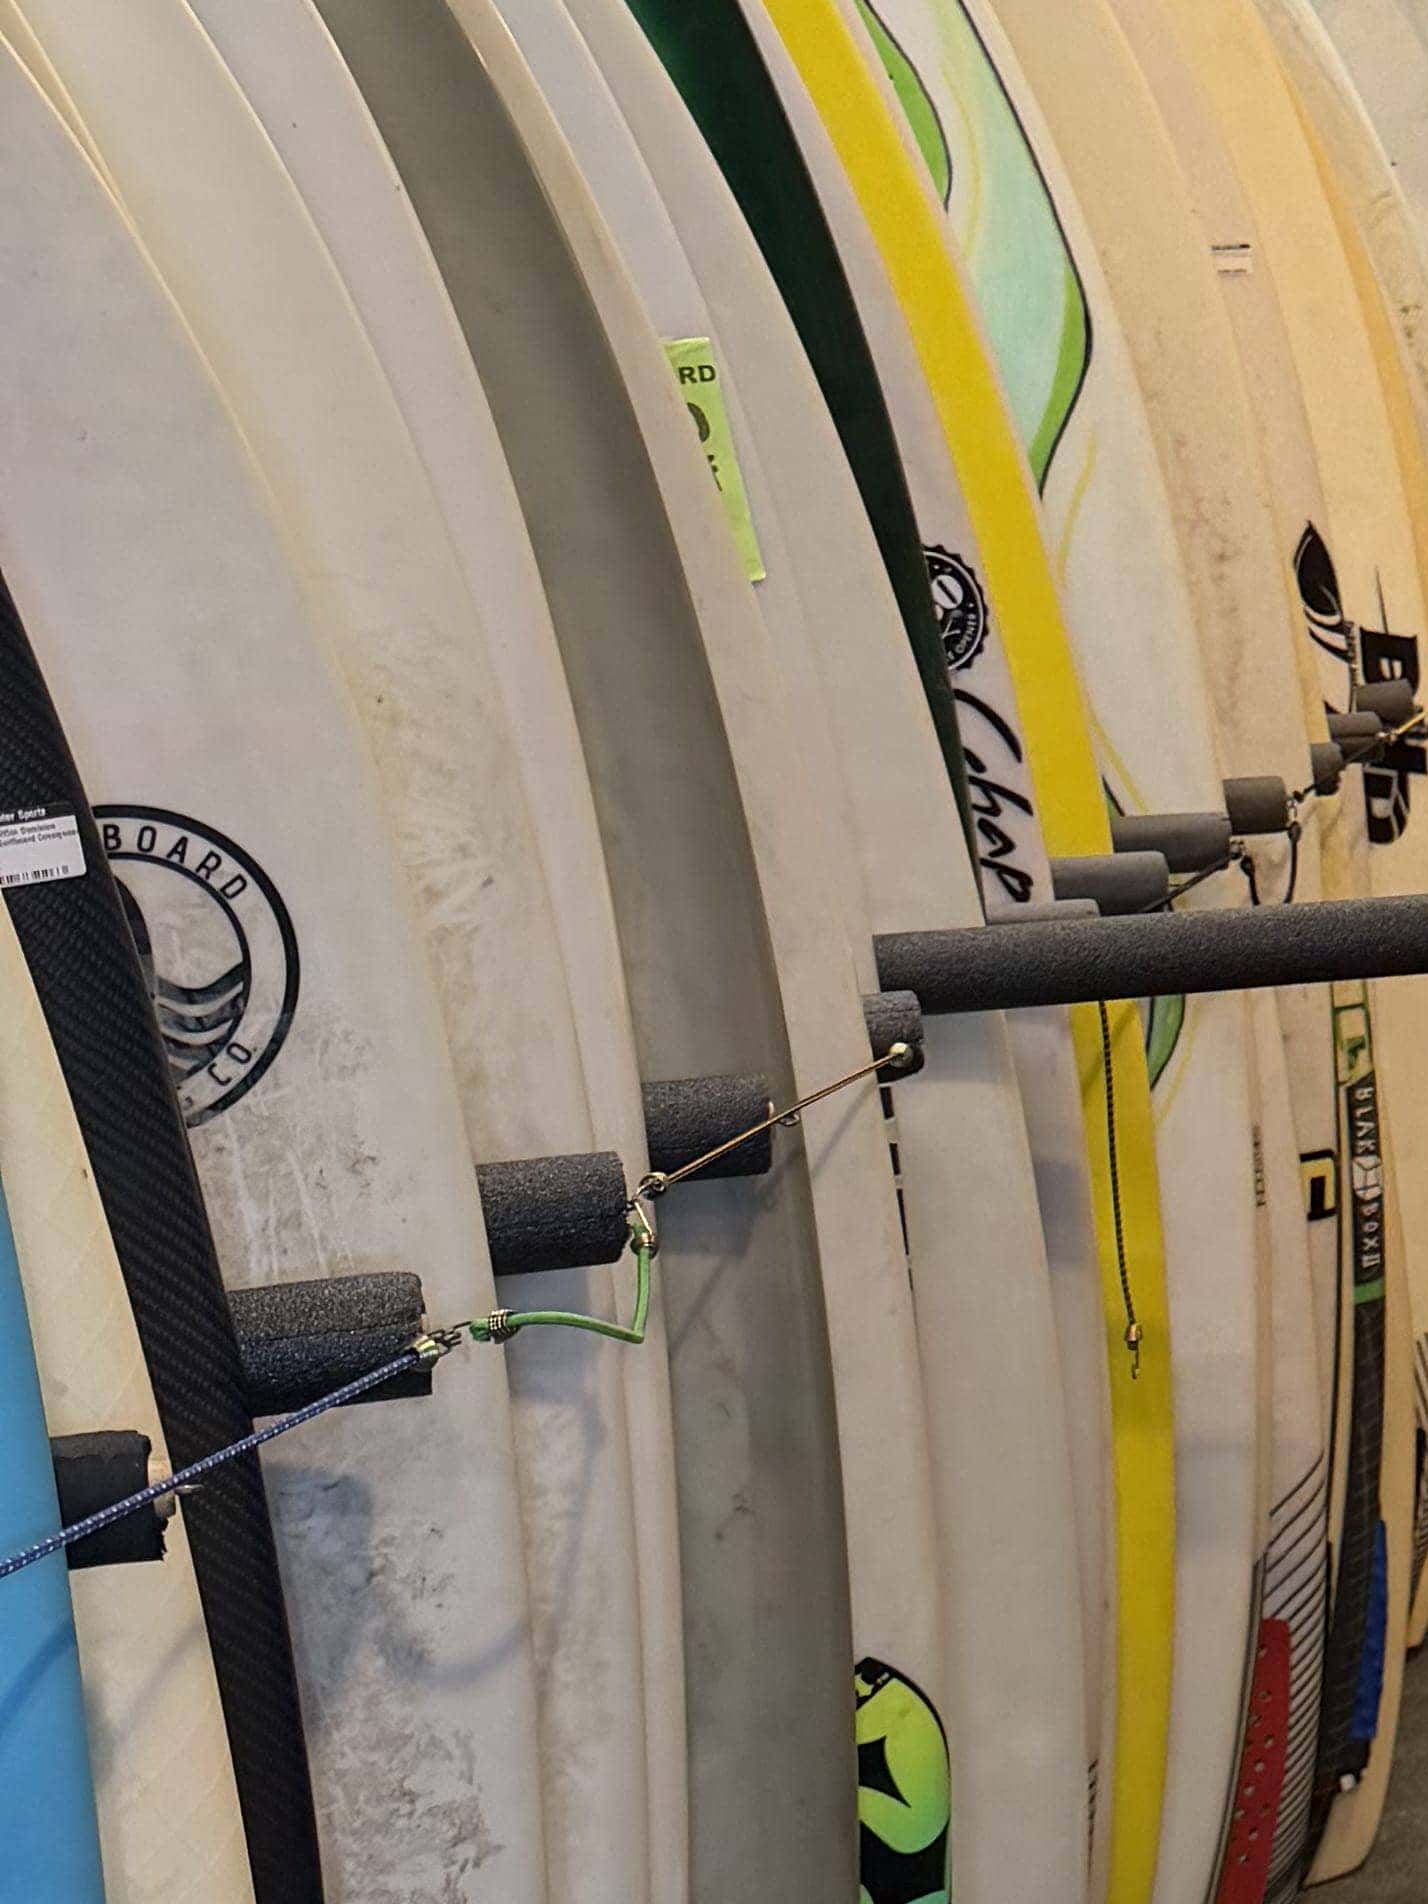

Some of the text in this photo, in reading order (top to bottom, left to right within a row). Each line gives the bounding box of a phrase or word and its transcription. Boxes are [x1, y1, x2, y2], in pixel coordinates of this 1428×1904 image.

[678, 364, 717, 385] RD
[103, 823, 249, 900] BOARD
[1354, 1085, 1377, 1156] BLAK
